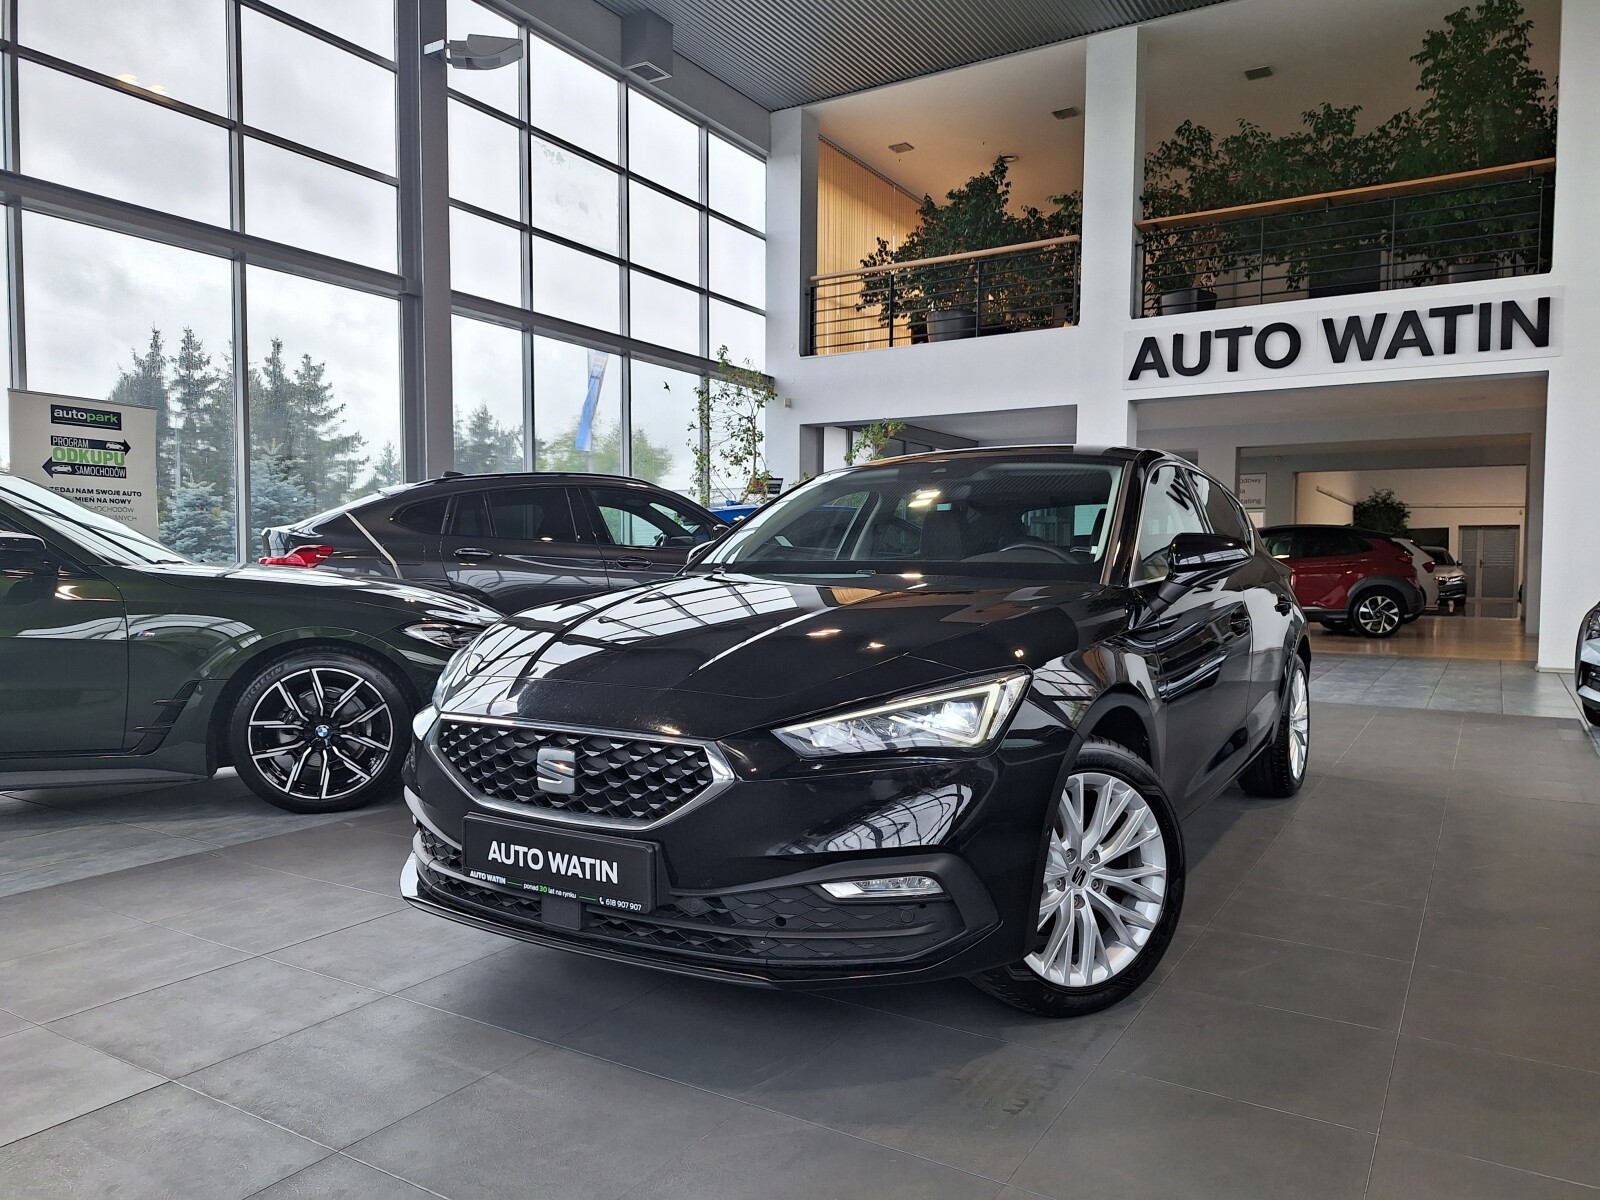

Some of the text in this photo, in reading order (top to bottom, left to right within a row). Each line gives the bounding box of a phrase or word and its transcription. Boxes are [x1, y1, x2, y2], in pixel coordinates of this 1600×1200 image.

[1128, 296, 1551, 380] AUTO WATIN
[54, 408, 118, 423] autopark
[52, 436, 89, 448] PROGRAM
[52, 447, 125, 466] ODKUPU
[75, 465, 126, 477] SAMOCHODÓW
[487, 840, 618, 884] AUTO WATIN
[470, 870, 506, 884] AUTO WATIN
[523, 883, 539, 892] ponad
[539, 885, 548, 893] 30
[562, 891, 577, 899] rynku
[605, 898, 642, 911] 618 907 907
